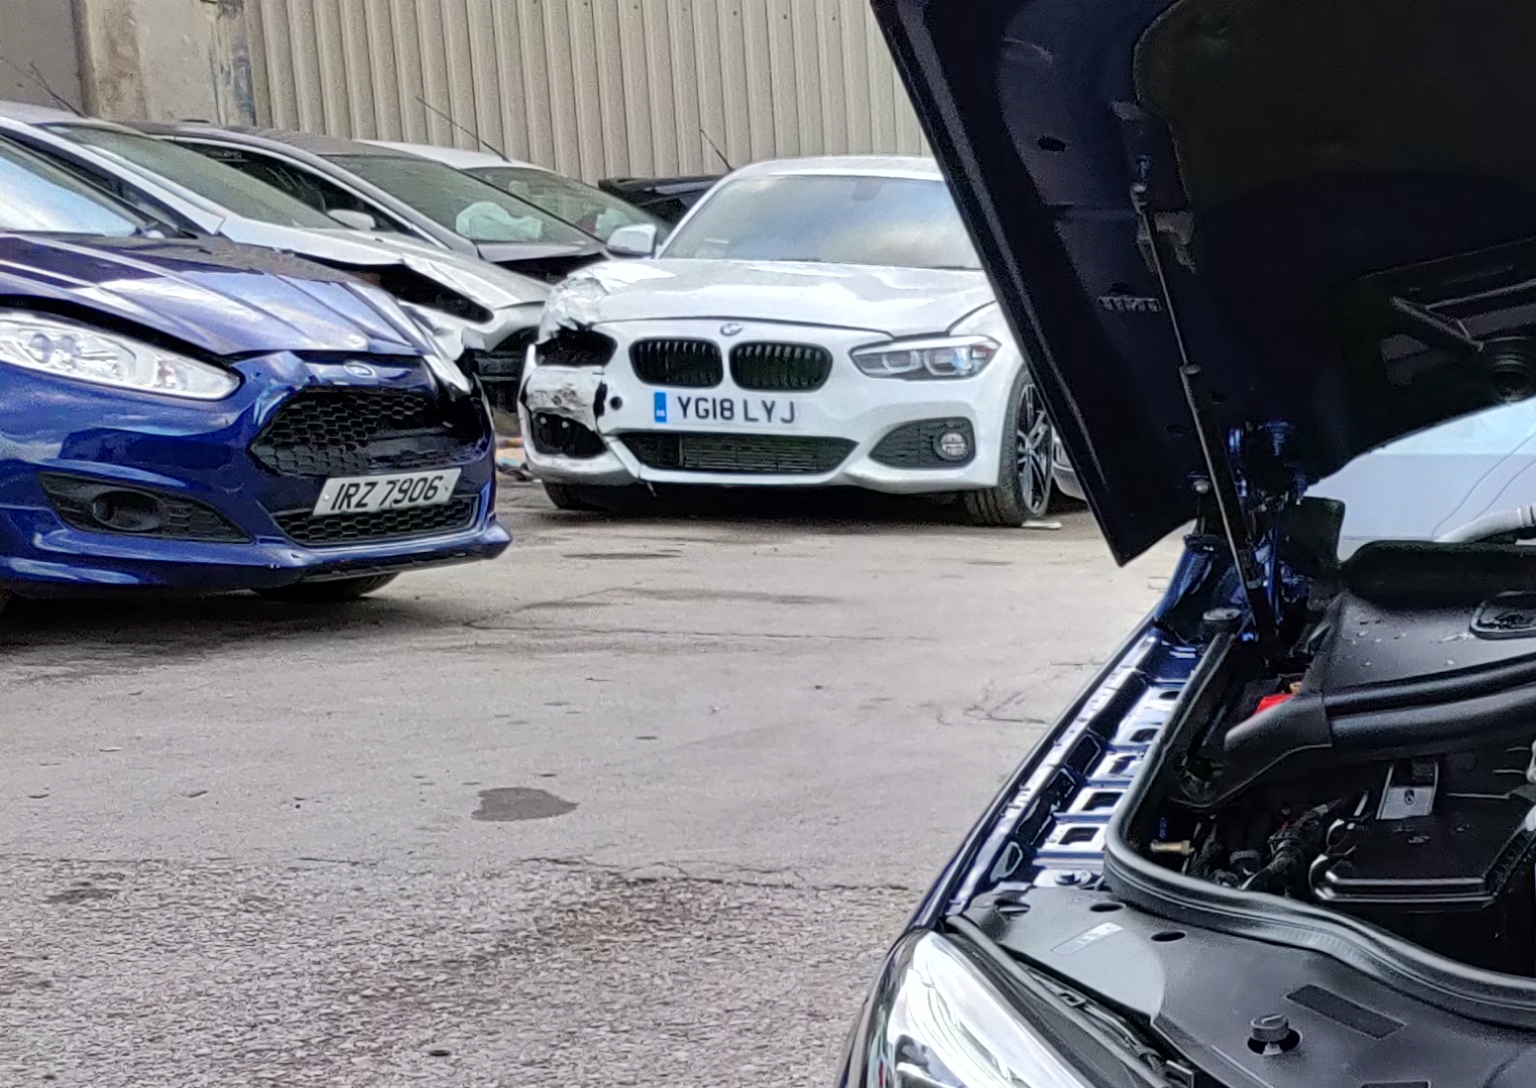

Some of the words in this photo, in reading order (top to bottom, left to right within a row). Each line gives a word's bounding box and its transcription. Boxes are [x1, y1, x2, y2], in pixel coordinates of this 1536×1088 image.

[678, 397, 734, 420] YG18
[744, 399, 795, 424] LYJ
[331, 481, 378, 510] IRZ
[379, 476, 443, 507] 7906
